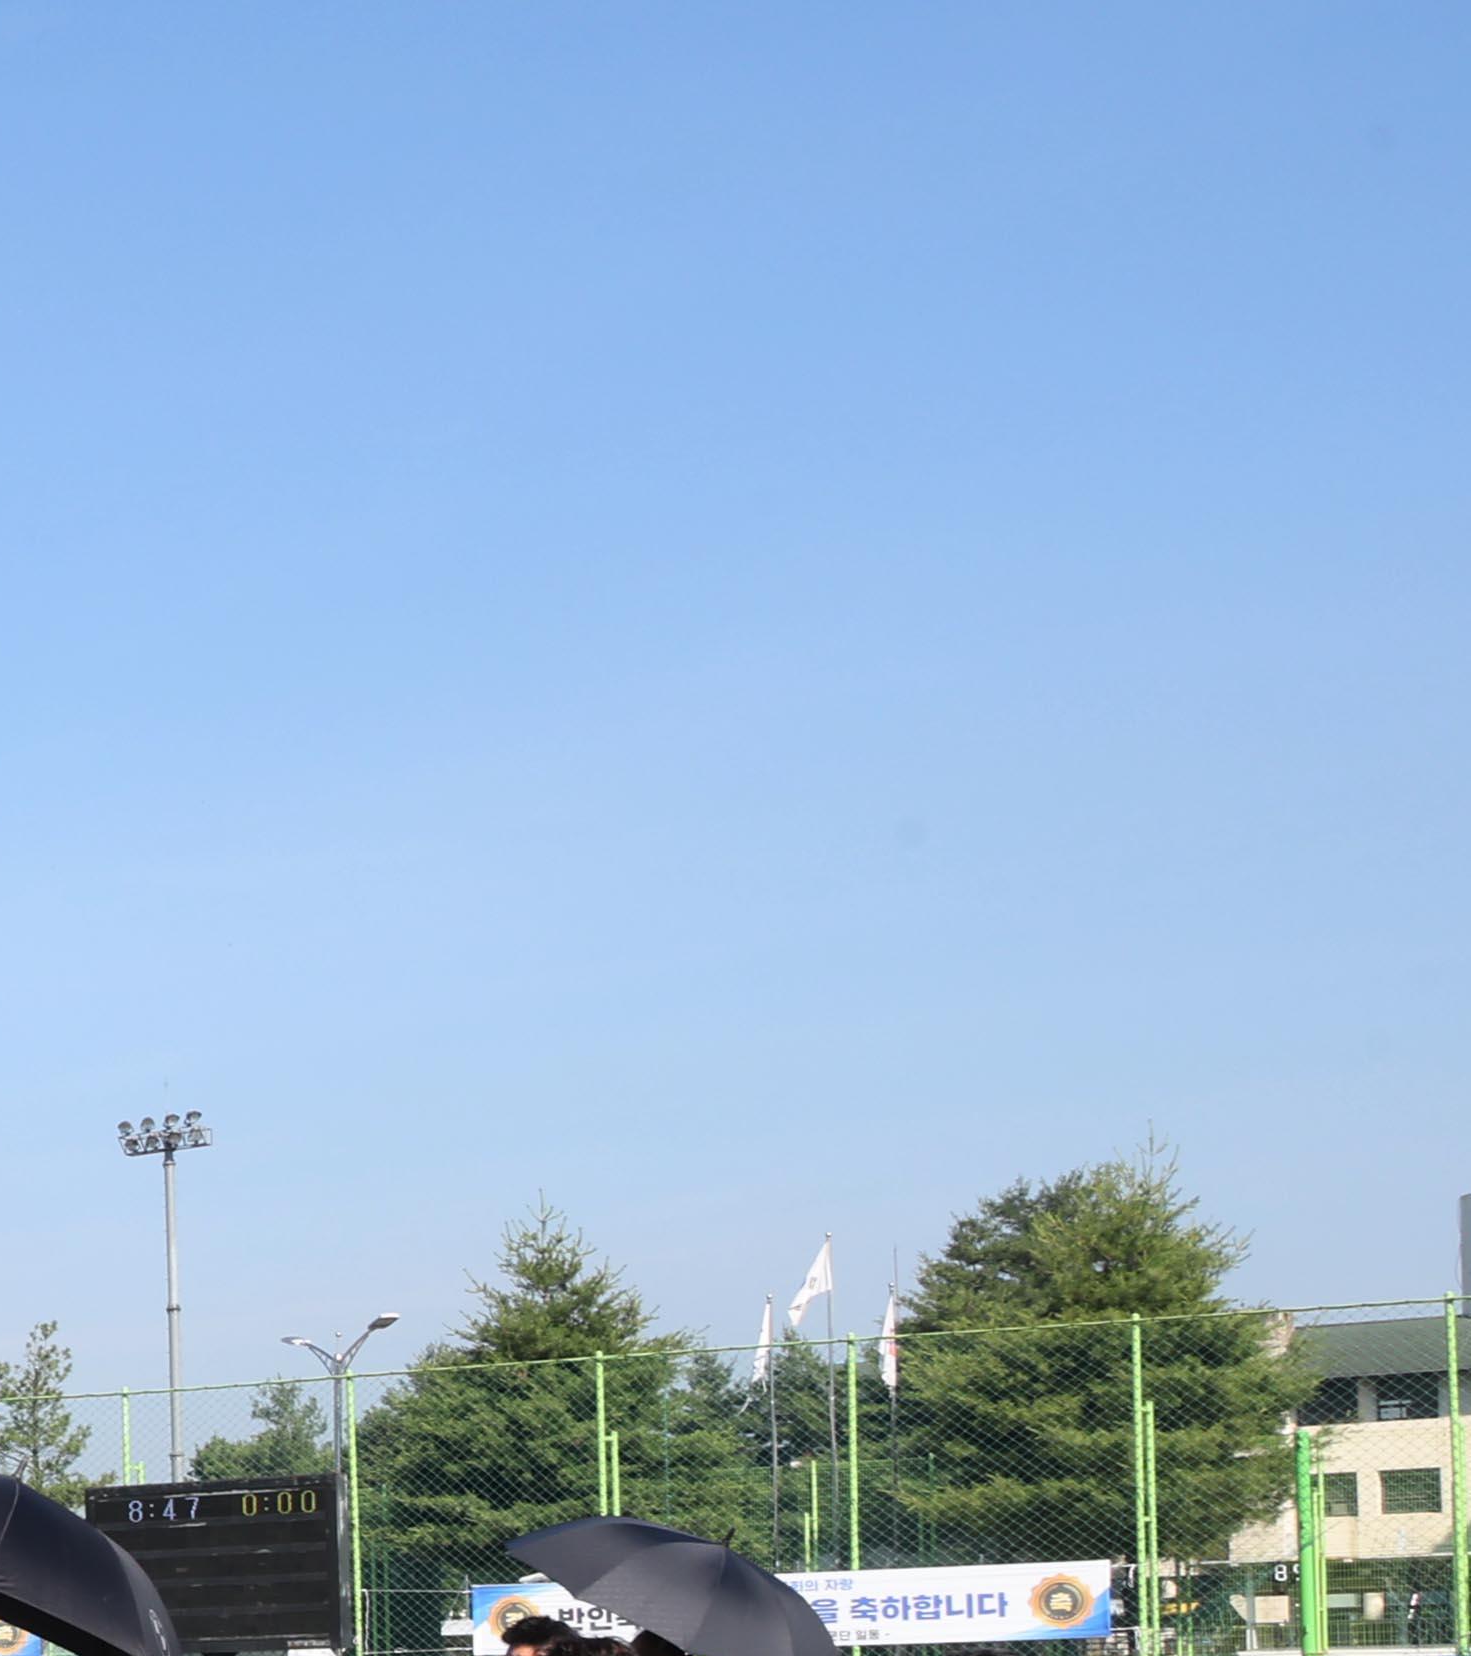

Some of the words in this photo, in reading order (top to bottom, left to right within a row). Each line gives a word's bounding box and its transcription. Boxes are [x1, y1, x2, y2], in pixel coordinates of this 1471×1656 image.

[128, 1496, 200, 1523] 8:47
[241, 1489, 317, 1517] 0:00
[825, 1578, 854, 1592] 자랑
[558, 1606, 634, 1632] 반인
[849, 1592, 1009, 1624] 축하합니다
